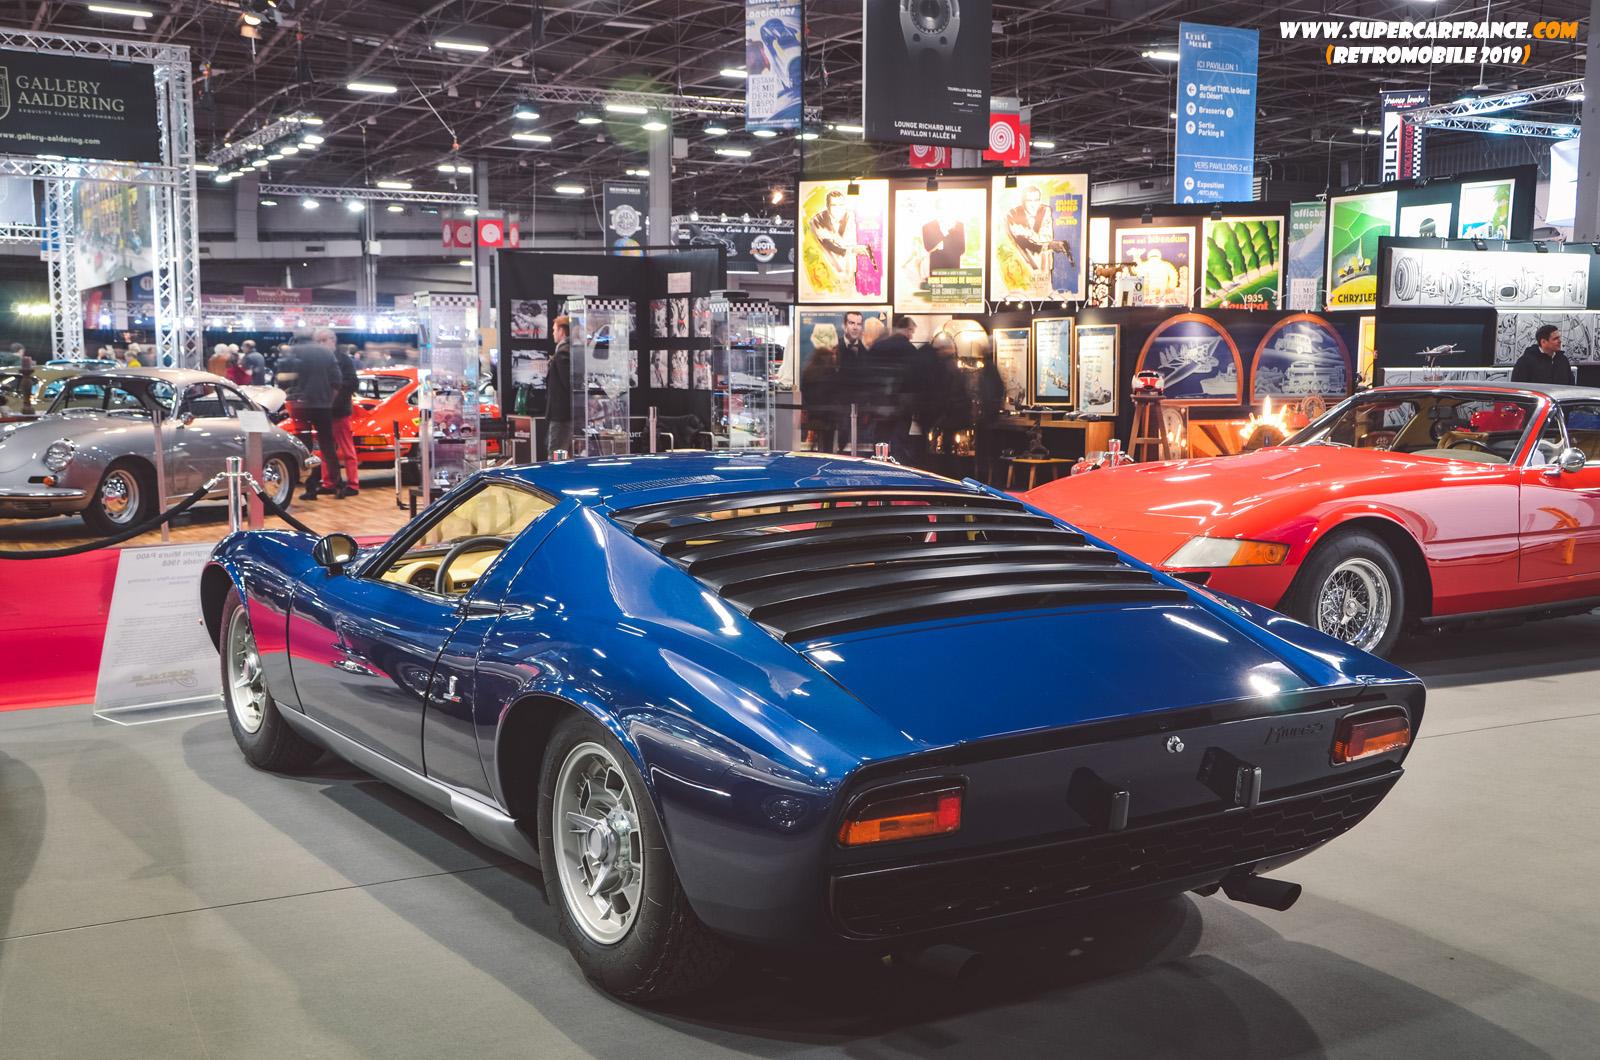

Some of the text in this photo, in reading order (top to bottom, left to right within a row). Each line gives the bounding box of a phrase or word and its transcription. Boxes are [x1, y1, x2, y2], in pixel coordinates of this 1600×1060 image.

[1206, 62, 1234, 71] PAVILLON
[16, 75, 100, 95] GALLERY
[1199, 84, 1217, 92] Berliet
[17, 91, 125, 112] AALDERING
[1199, 106, 1225, 115] Brasserie
[894, 120, 917, 129] LOUNGE
[918, 122, 944, 131] RICHARD
[1198, 121, 1215, 129] Sortie
[900, 129, 928, 138] PAVILLON
[932, 131, 951, 140] ALLÉE
[1198, 129, 1219, 138] Parking
[1405, 125, 1414, 136] CAR
[1384, 124, 1399, 182] BILIA
[1209, 162, 1238, 171] PAVILLONS
[1197, 181, 1224, 189] Exposition
[1147, 234, 1187, 244] bibendum
[1244, 294, 1263, 302] 1935
[1337, 292, 1377, 304] CHRYSLER
